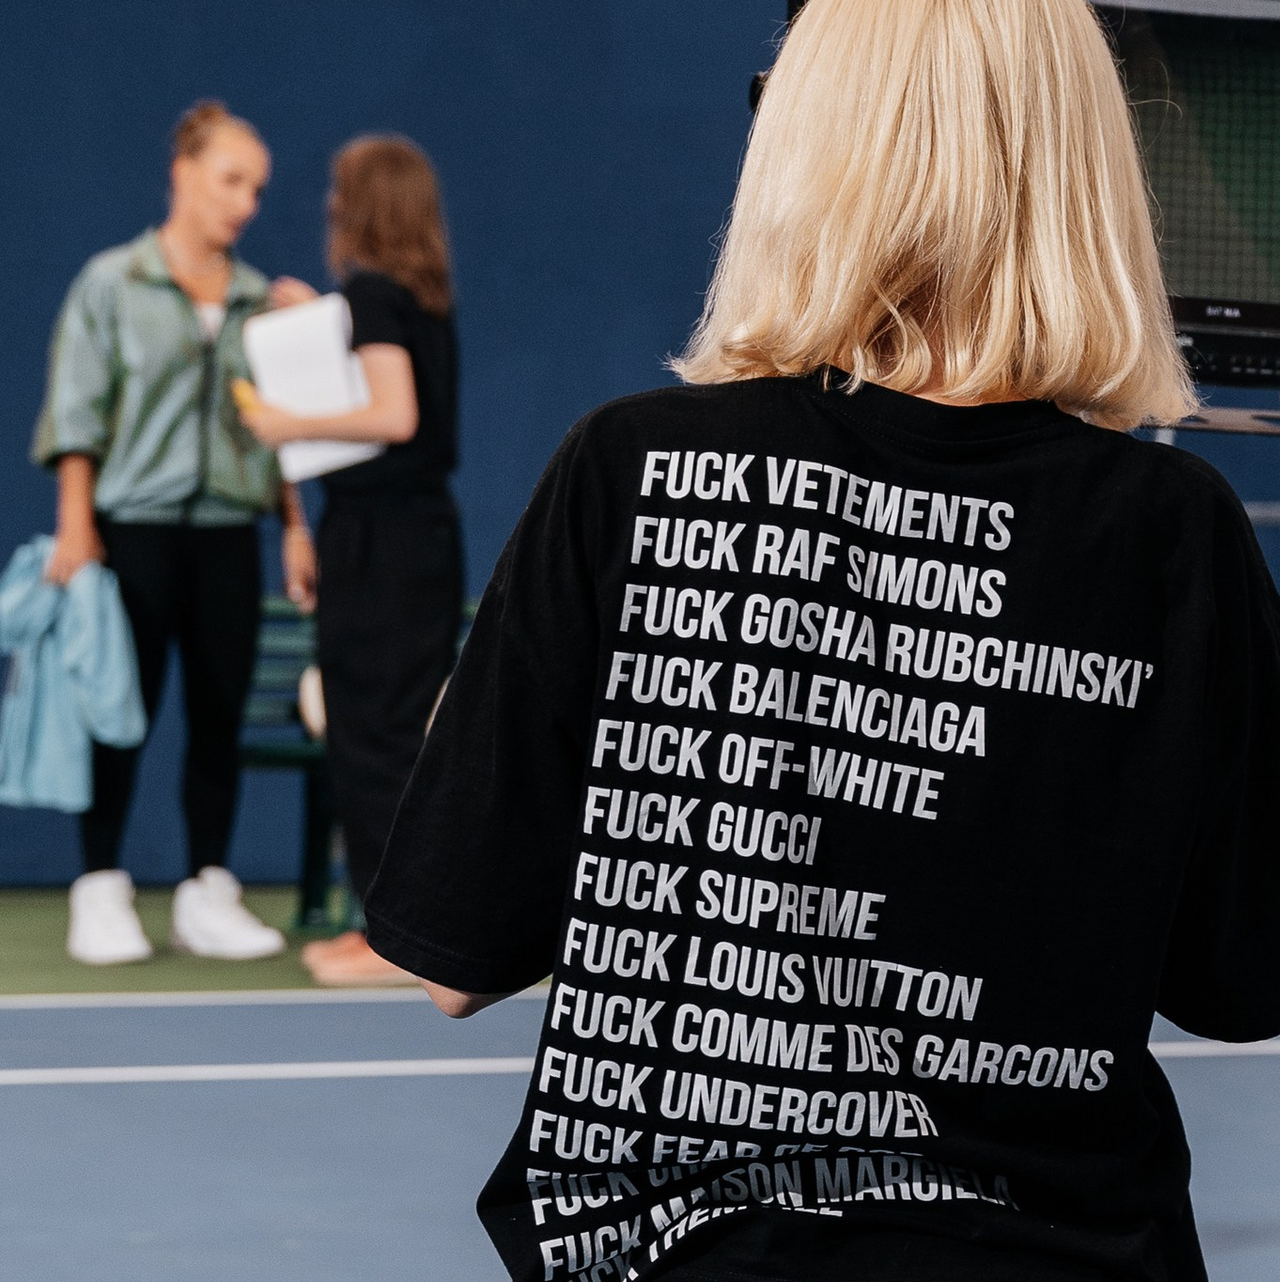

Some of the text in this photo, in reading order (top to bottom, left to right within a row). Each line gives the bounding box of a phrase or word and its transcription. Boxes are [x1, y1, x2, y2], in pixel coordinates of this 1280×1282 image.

[640, 451, 1014, 551] FUCK VETEMENTS
[631, 516, 1006, 617] FUCK RAF SIMONS
[619, 584, 734, 641] FUCK
[741, 594, 875, 666] GOSHA
[605, 651, 985, 757] FUCK BALENCIAGA
[592, 719, 944, 820] FUCK OFF-WHITE
[583, 786, 821, 865] FUCK GUCCI
[574, 852, 886, 940] FUCK SUPREME
[563, 917, 983, 1021] FUCK LOUIS VUITTON
[551, 983, 1114, 1091] FUCK COMME DES GARCONS
[530, 1109, 643, 1164] FUCK
[539, 1046, 938, 1137] FUCK UNDERCOVER
[539, 1214, 641, 1282] FUCK
